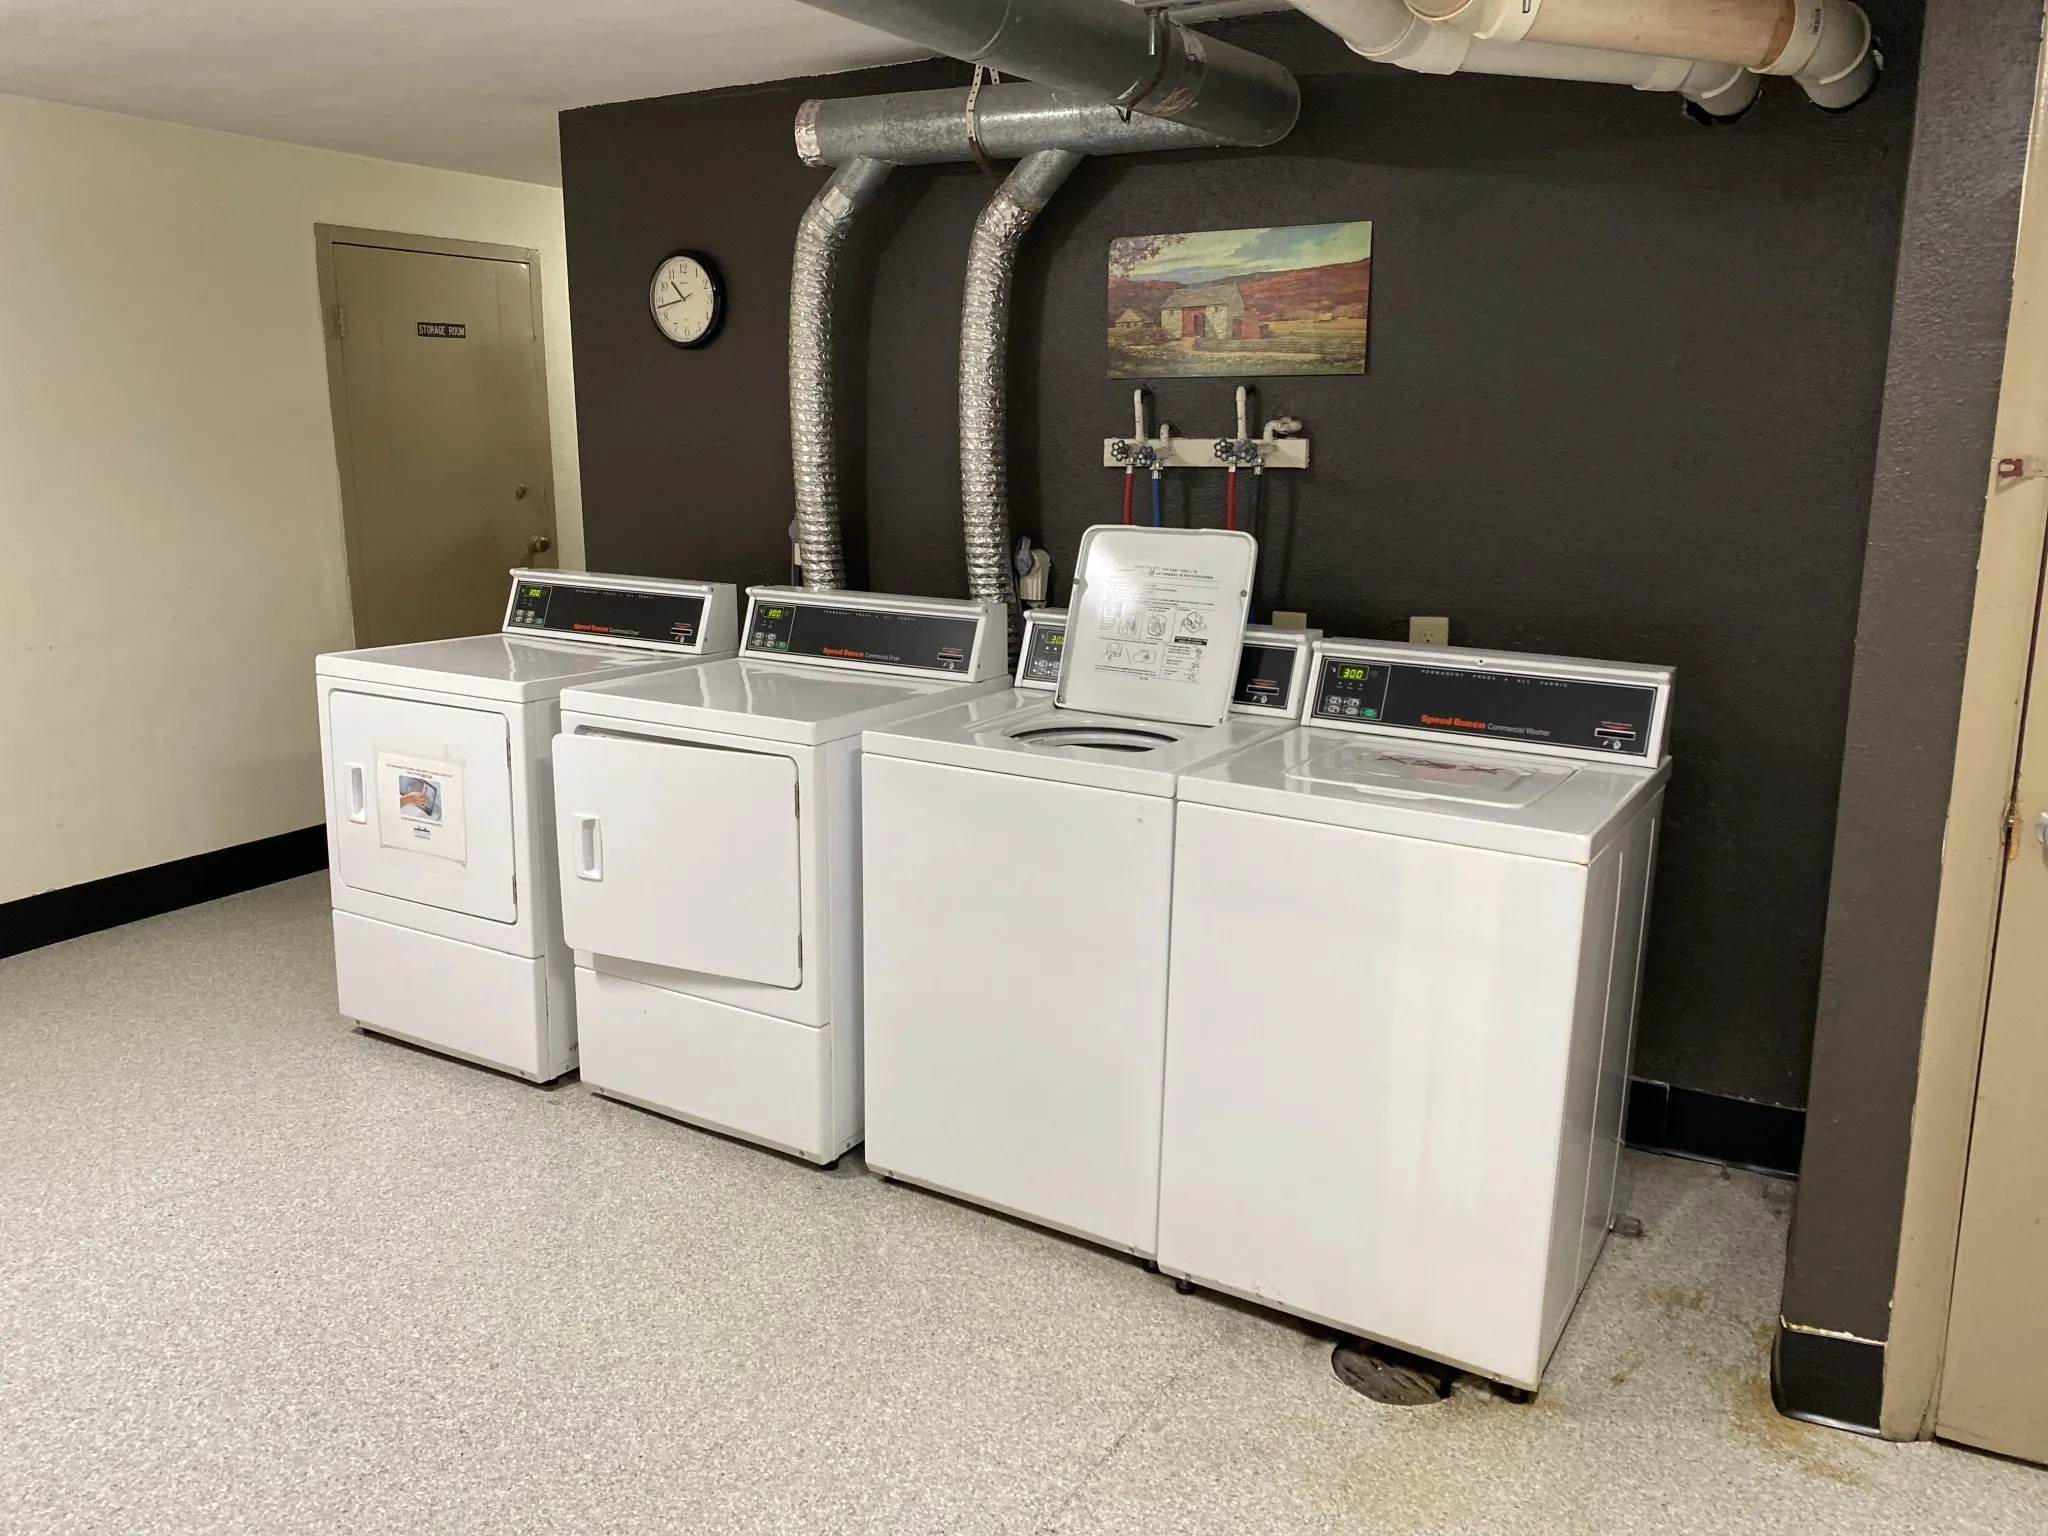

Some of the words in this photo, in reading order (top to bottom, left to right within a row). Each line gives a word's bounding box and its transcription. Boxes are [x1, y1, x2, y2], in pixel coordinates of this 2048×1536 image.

[668, 269, 675, 279] 11
[680, 263, 688, 274] 12
[660, 281, 668, 292] 10
[703, 279, 708, 290] 2
[708, 294, 713, 305] 3
[664, 312, 669, 322] 8
[418, 324, 446, 336] STORAGE
[448, 326, 465, 336] ROOM
[674, 322, 678, 333] 7
[684, 326, 690, 336] 6
[696, 322, 702, 332] 5
[528, 588, 541, 597] 300
[768, 608, 782, 618] 300
[823, 647, 844, 656] Speed
[1344, 668, 1364, 679] 300
[1420, 714, 1453, 724] Speed
[1454, 718, 1486, 729] Queen
[1488, 723, 1526, 734] Commercial
[1526, 727, 1550, 736] Washer
